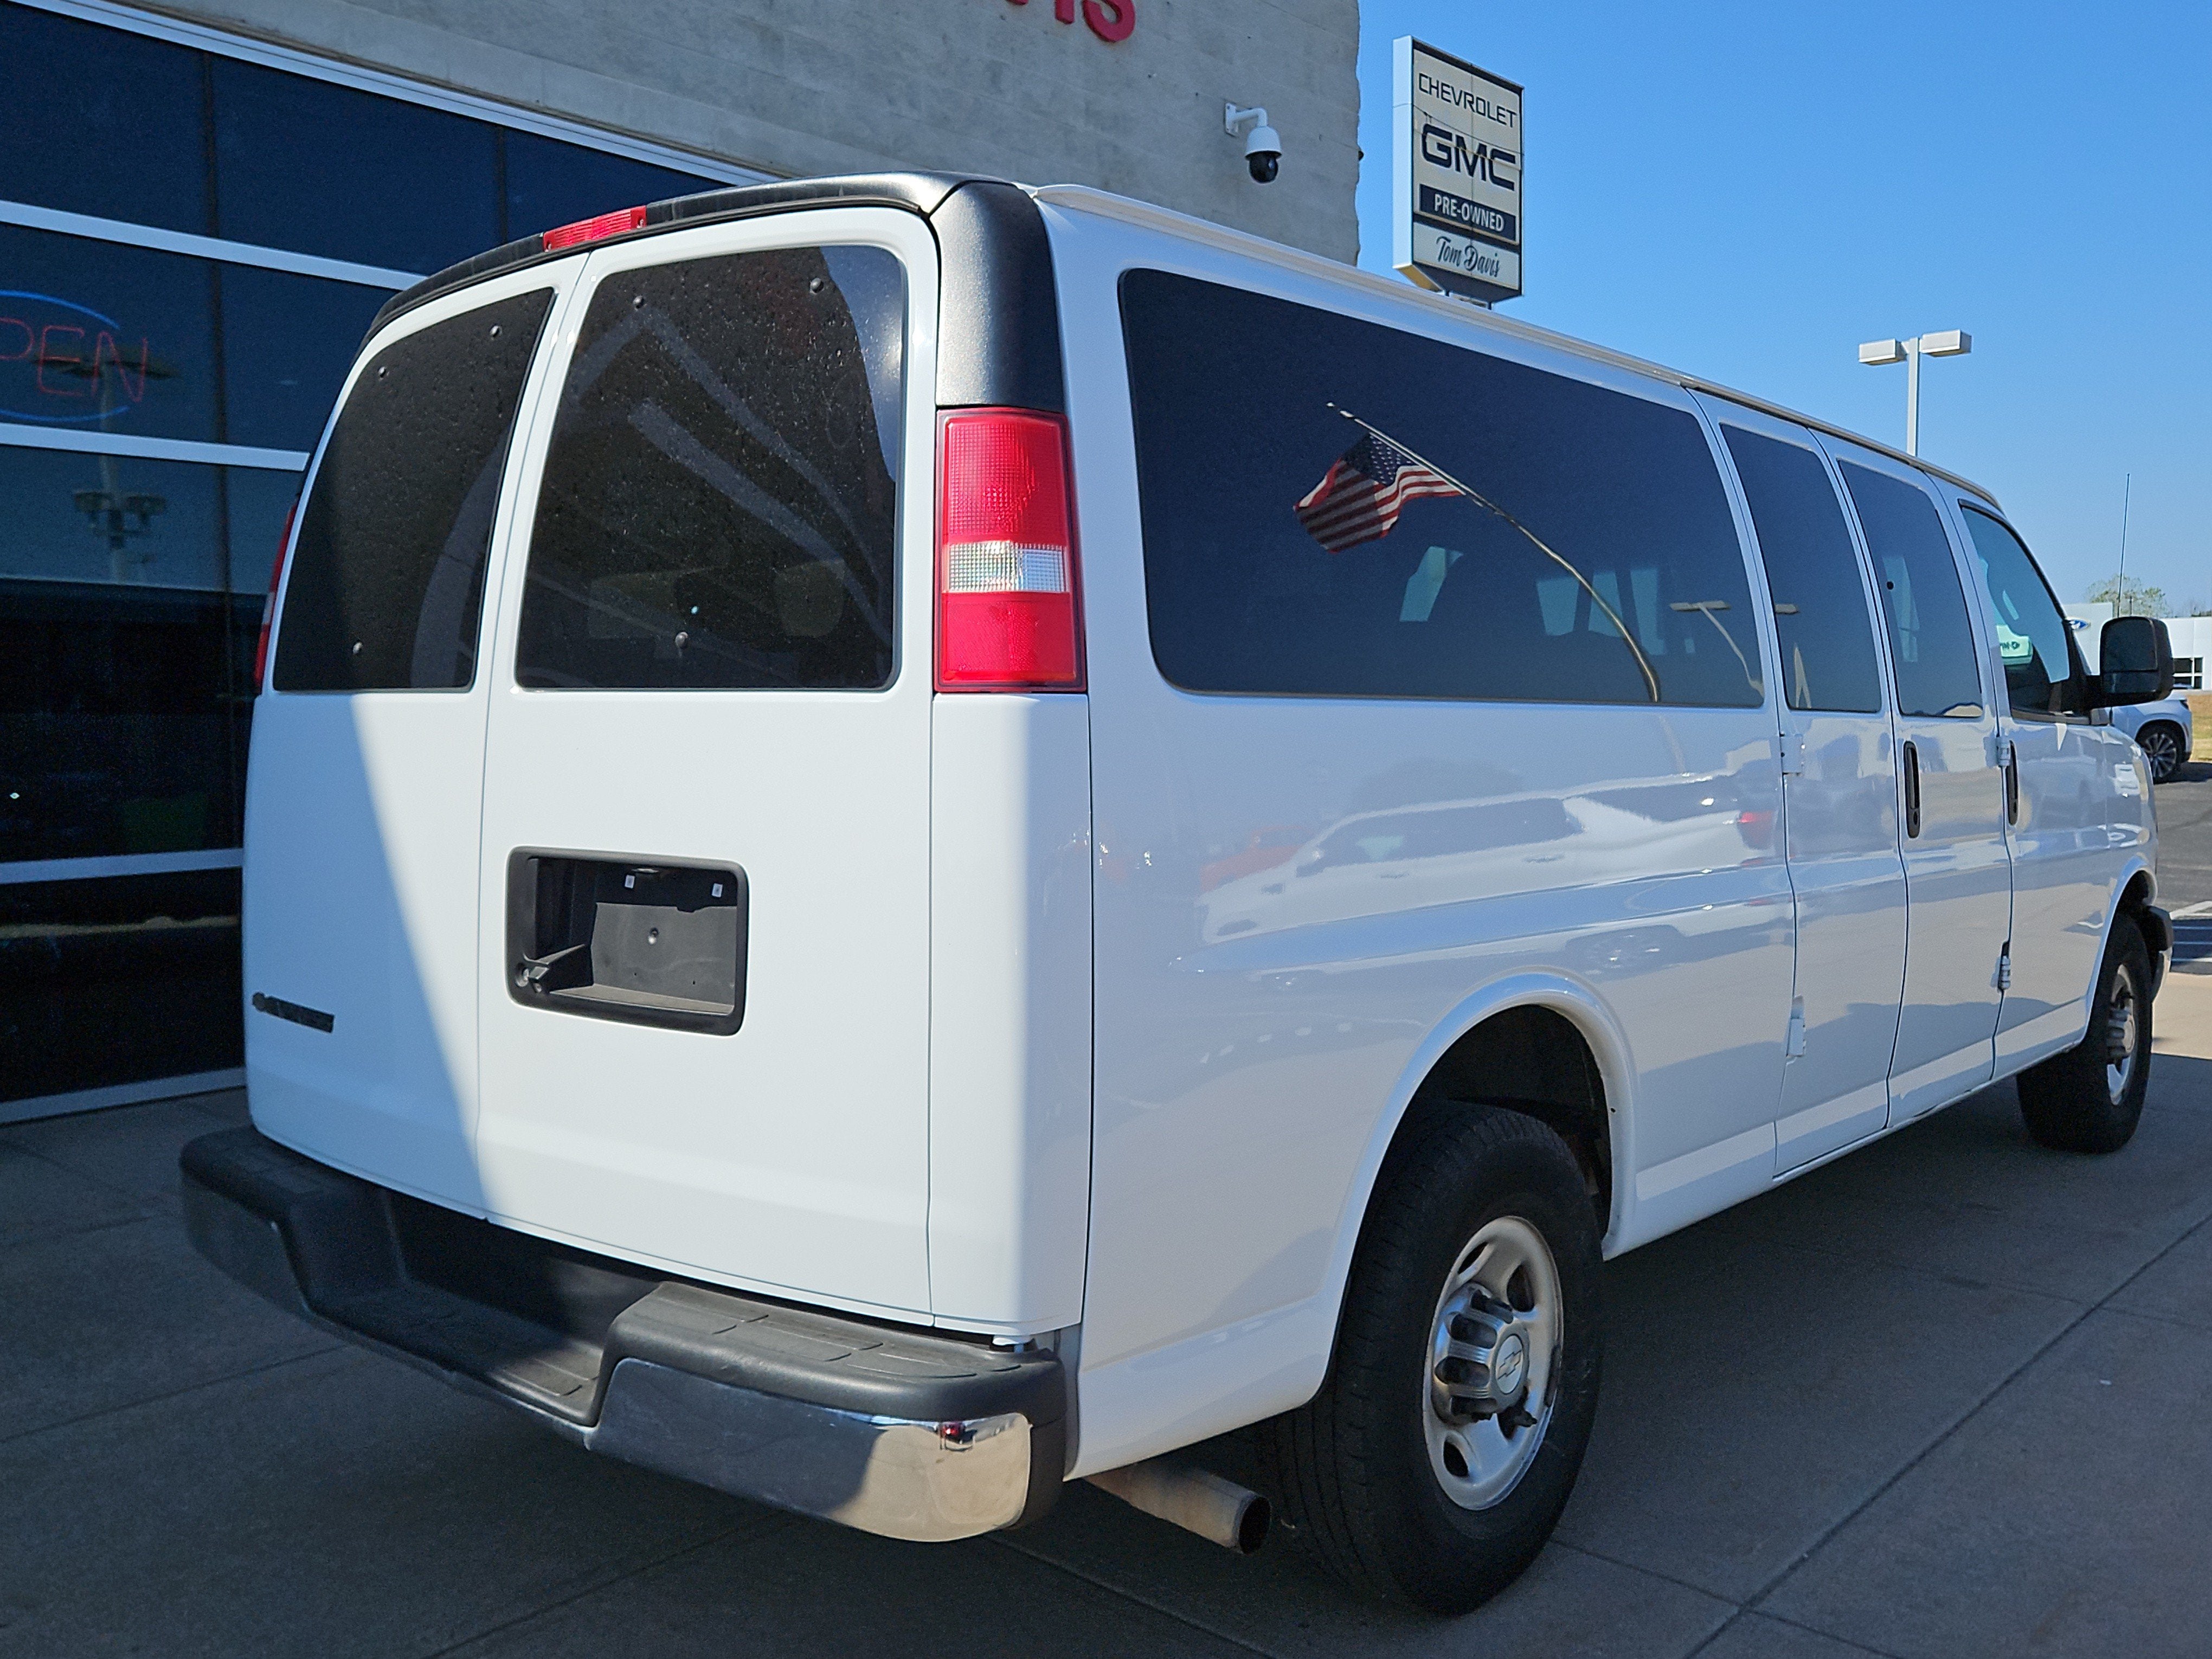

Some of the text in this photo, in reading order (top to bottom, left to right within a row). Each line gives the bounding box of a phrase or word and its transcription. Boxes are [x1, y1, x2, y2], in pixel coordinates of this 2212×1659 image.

[1419, 72, 1517, 128] CHEVROLET
[1421, 123, 1516, 191] GMC
[1435, 193, 1504, 232] PRE-OWNED
[1436, 236, 1501, 278] Tom Davis
